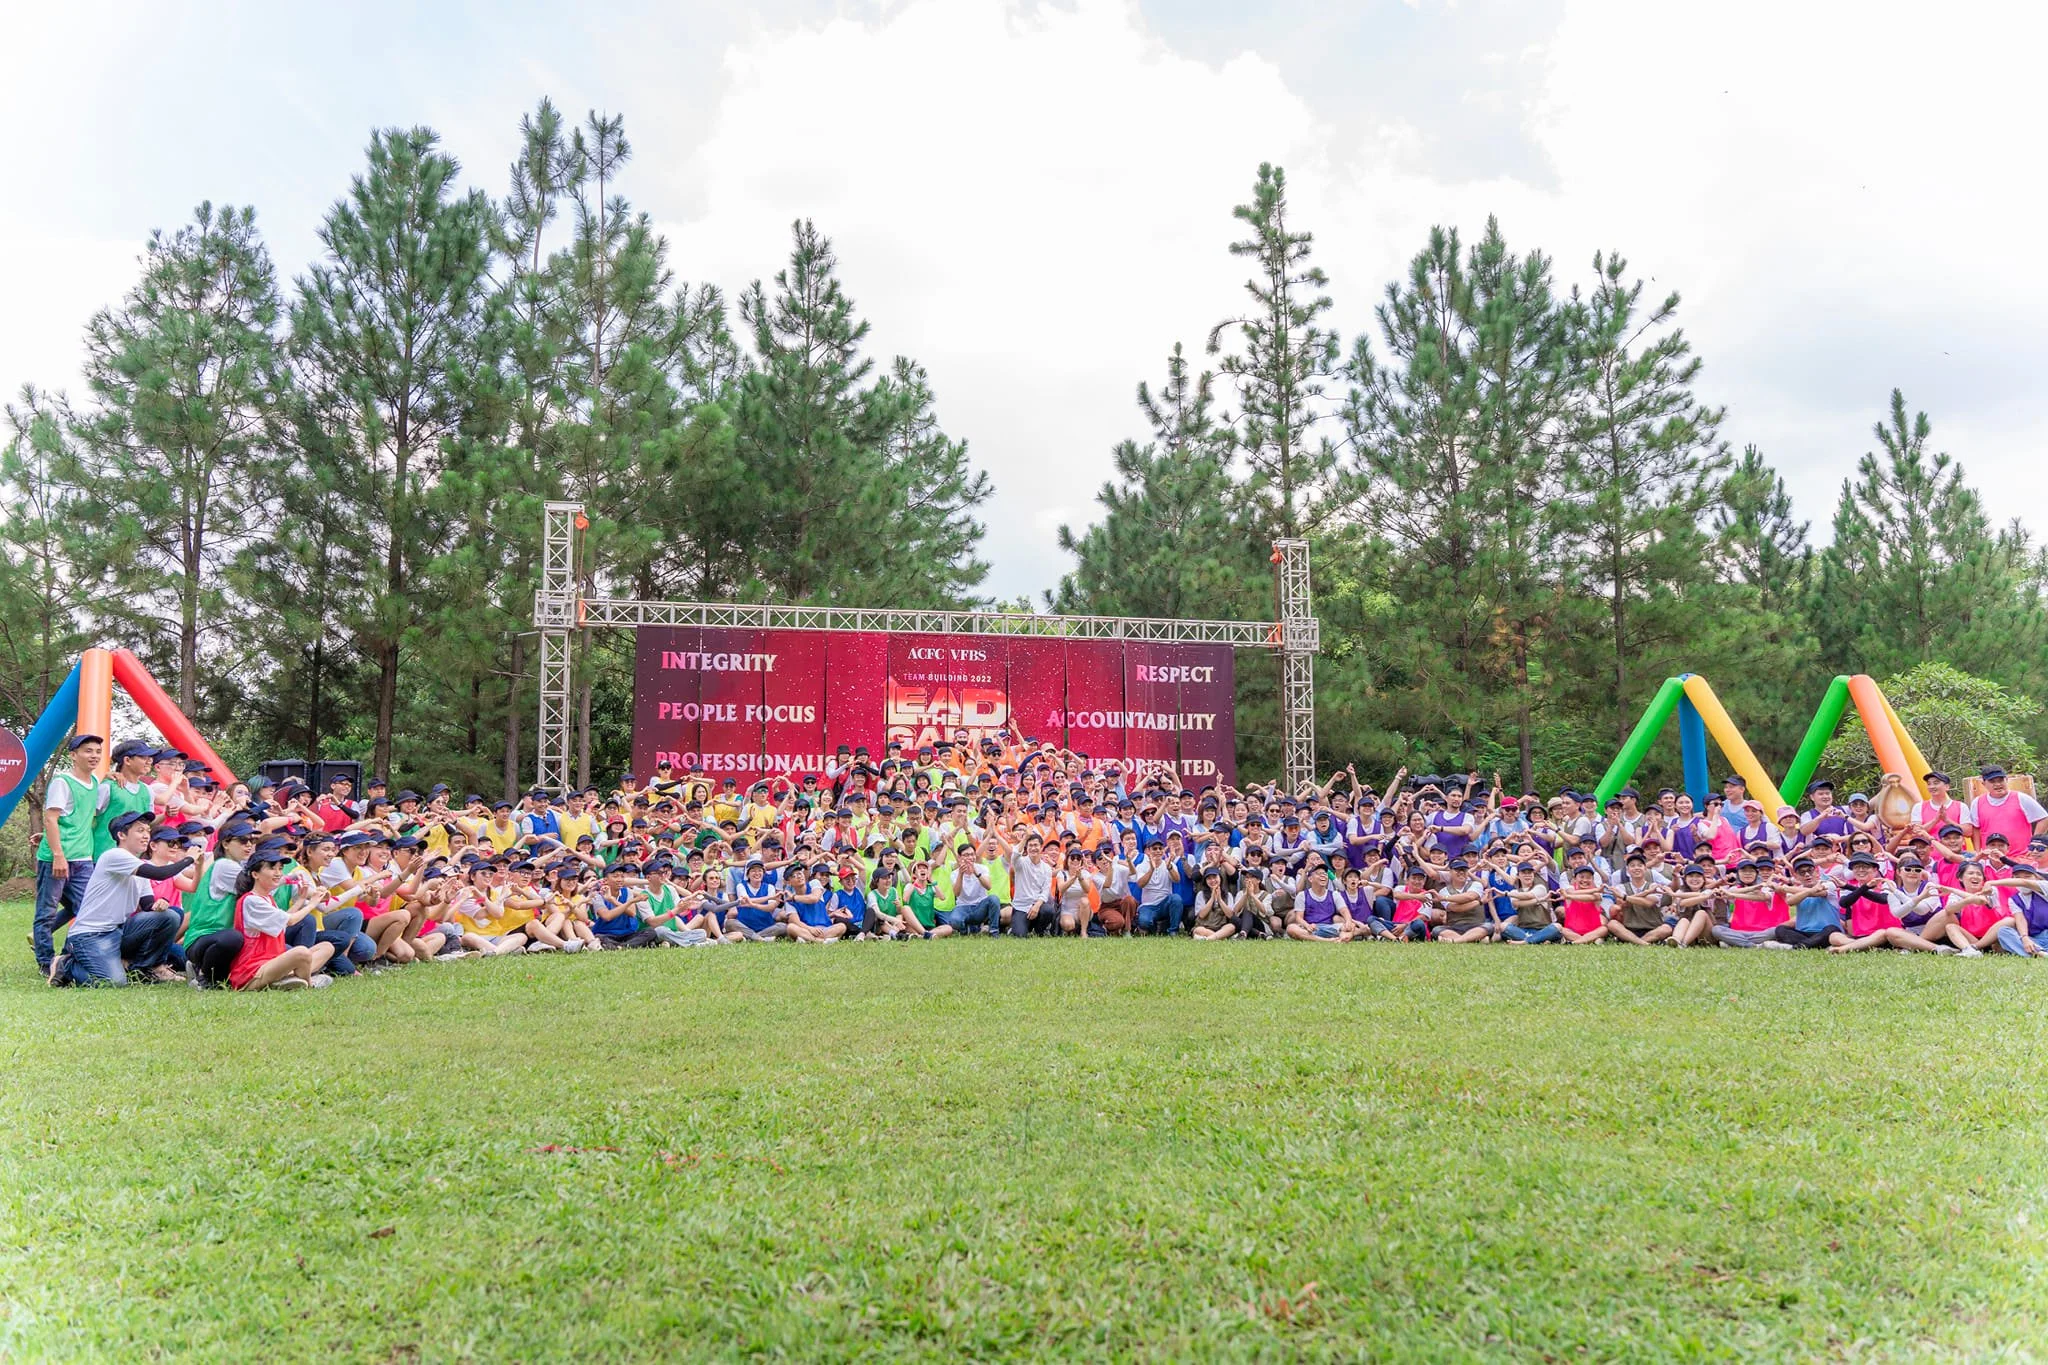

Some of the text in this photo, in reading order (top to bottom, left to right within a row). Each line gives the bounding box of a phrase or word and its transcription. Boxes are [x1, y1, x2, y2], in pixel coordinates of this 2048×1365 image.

[661, 651, 778, 672] INTEGRITY
[907, 648, 987, 661] ACFC VFBS
[903, 673, 992, 683] TEAM BUILDING 2022
[1136, 664, 1214, 683] RESPECT
[884, 676, 1012, 727] LEAD
[658, 702, 816, 723] PEOPLE FOCUS
[918, 713, 961, 726] THE
[1046, 710, 1217, 731] ACCOUNTABILITY
